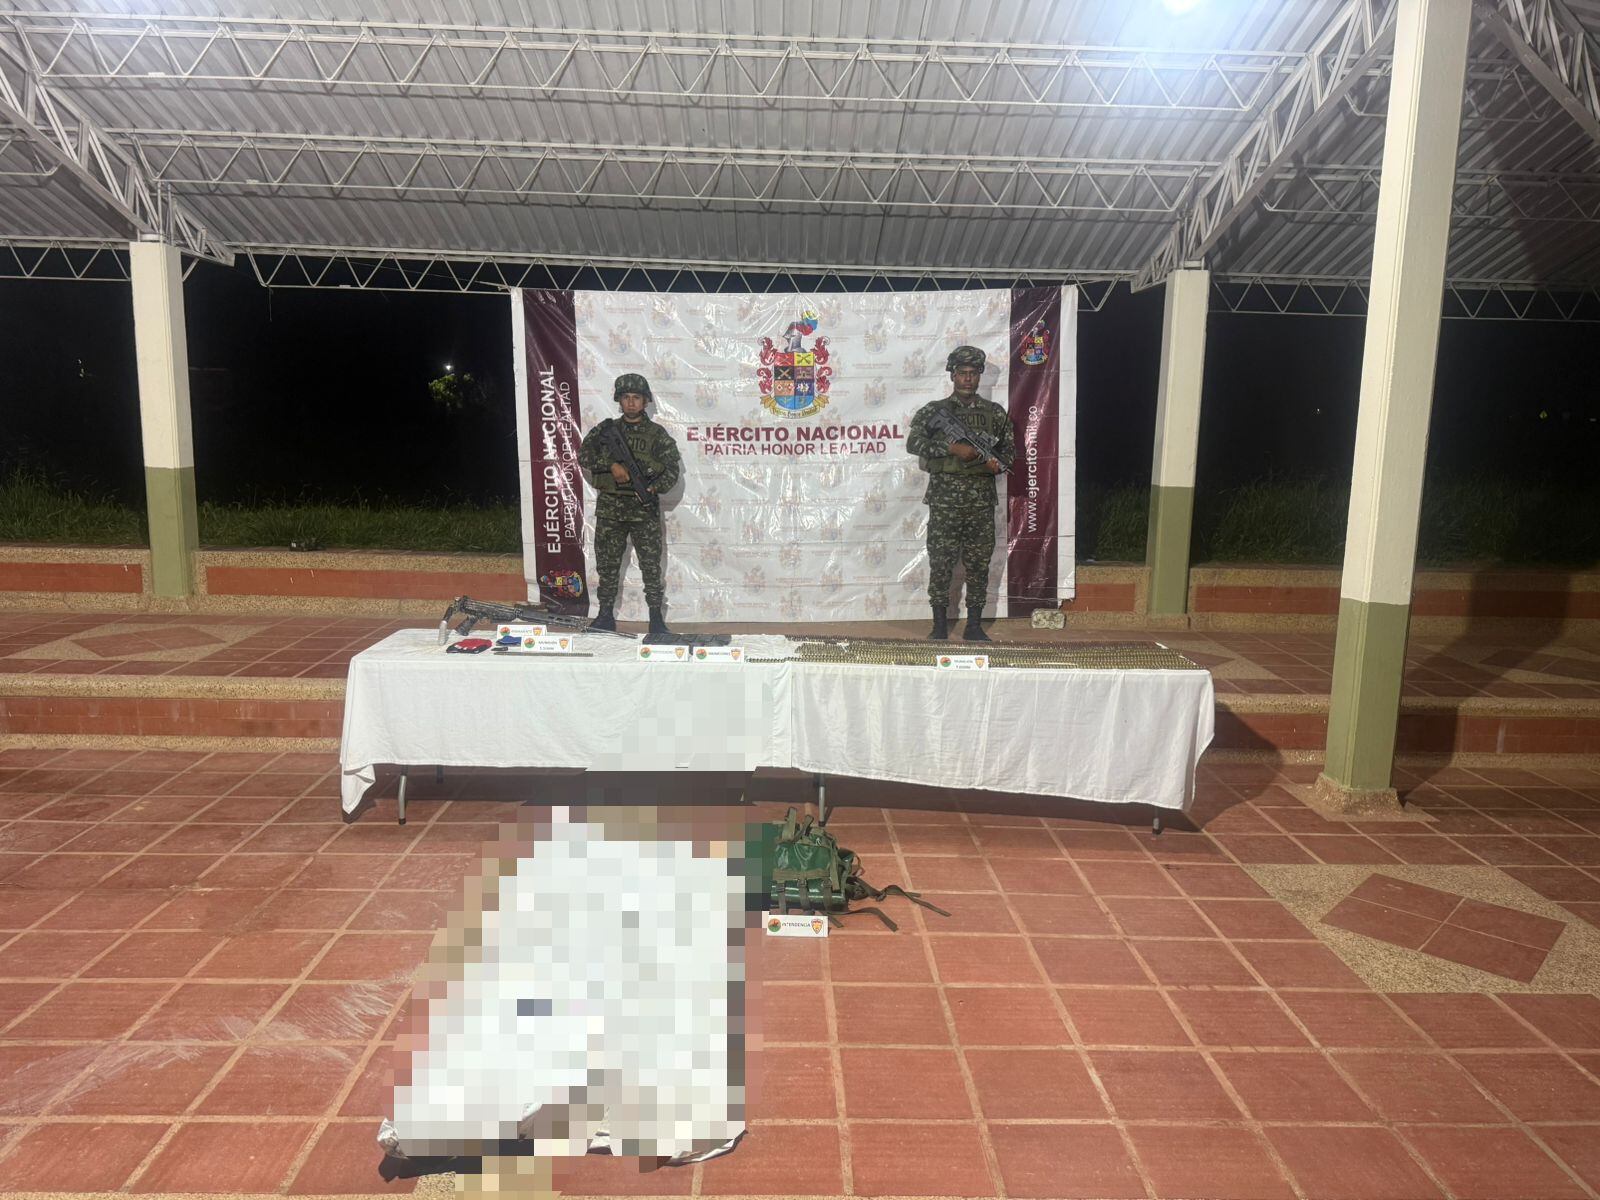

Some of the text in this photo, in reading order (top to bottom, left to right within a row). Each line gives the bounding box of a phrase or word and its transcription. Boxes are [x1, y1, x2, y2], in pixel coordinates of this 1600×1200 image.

[686, 423, 904, 442] EJÉRCITO NACIONAL
[540, 364, 561, 553] EJÉRCITO NACIONAL
[704, 442, 887, 456] PATRIA HONOR LEALTAD
